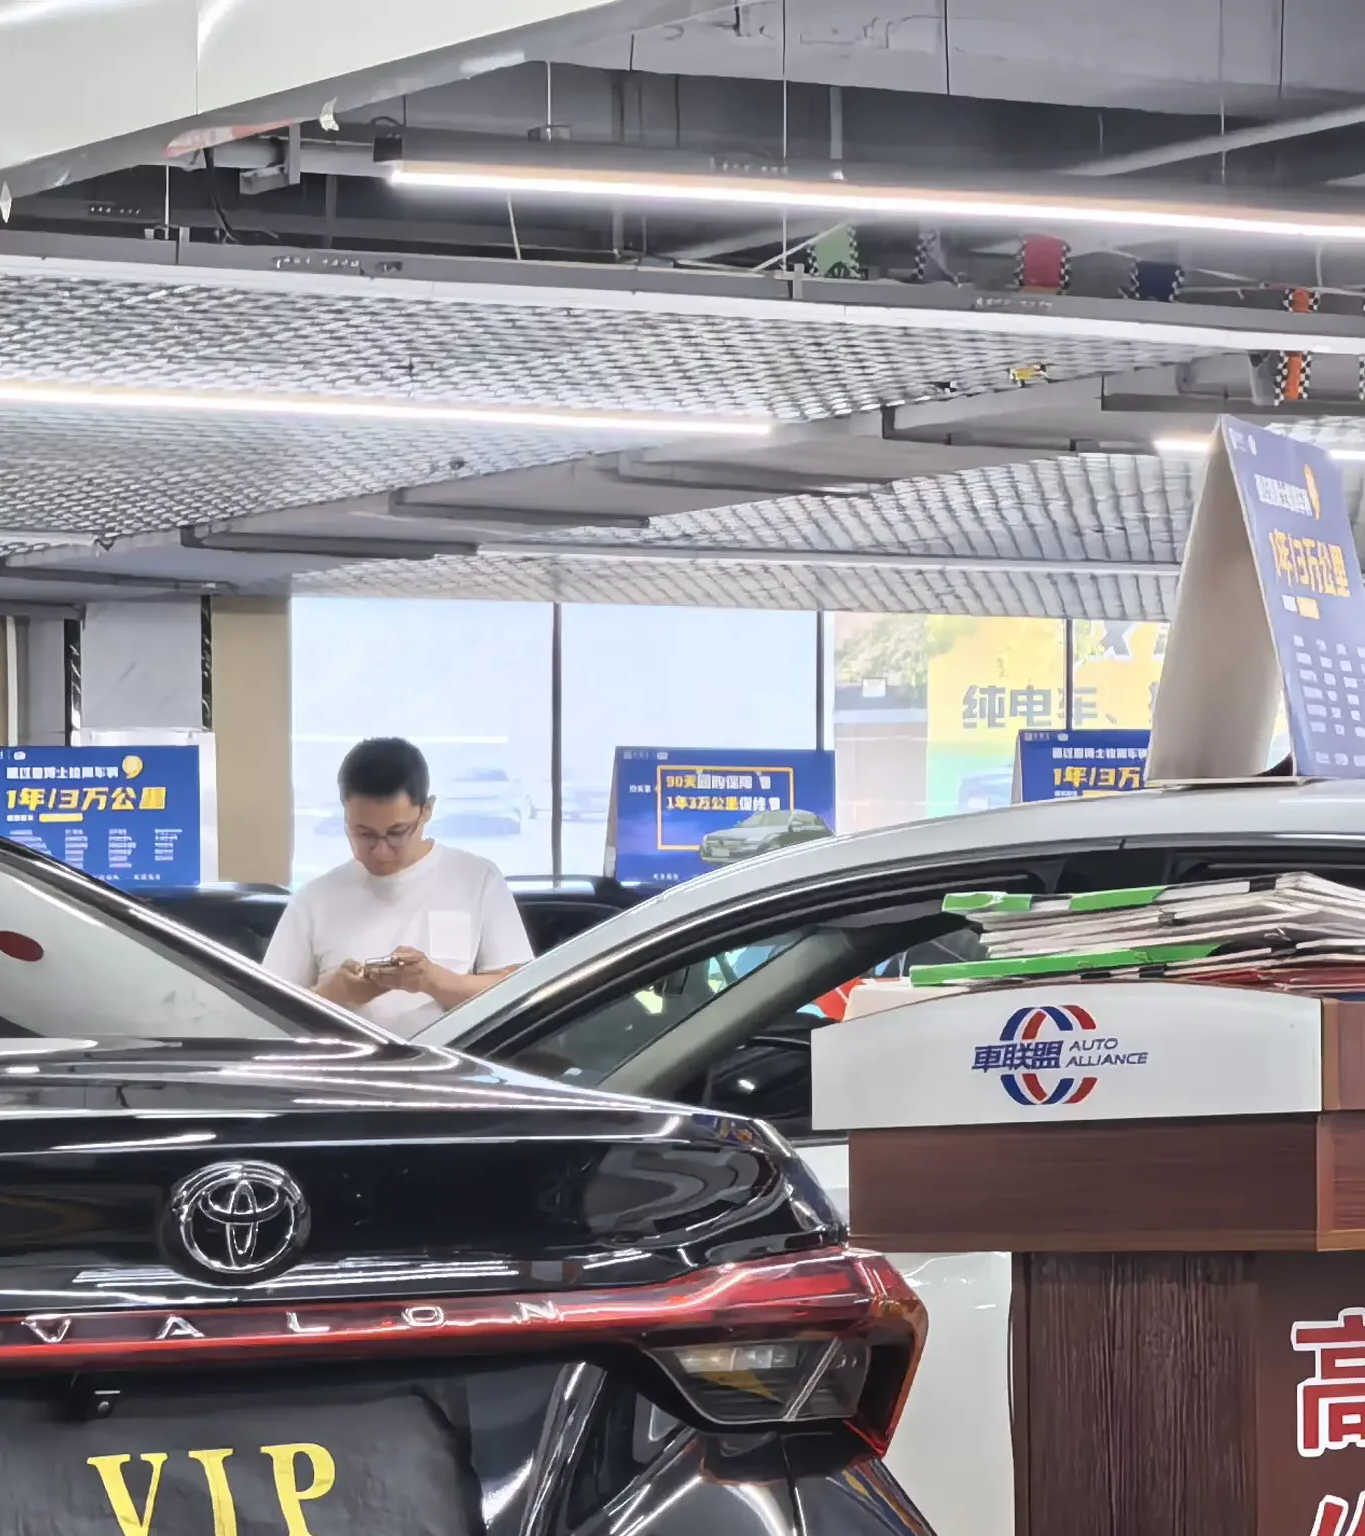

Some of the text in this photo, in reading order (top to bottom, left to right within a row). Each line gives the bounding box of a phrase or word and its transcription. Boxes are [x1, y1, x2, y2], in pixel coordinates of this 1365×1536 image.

[962, 683, 1159, 729] 纯电车、
[1069, 1037, 1119, 1052] AUTO
[1066, 1051, 1149, 1068] ALLIANCE
